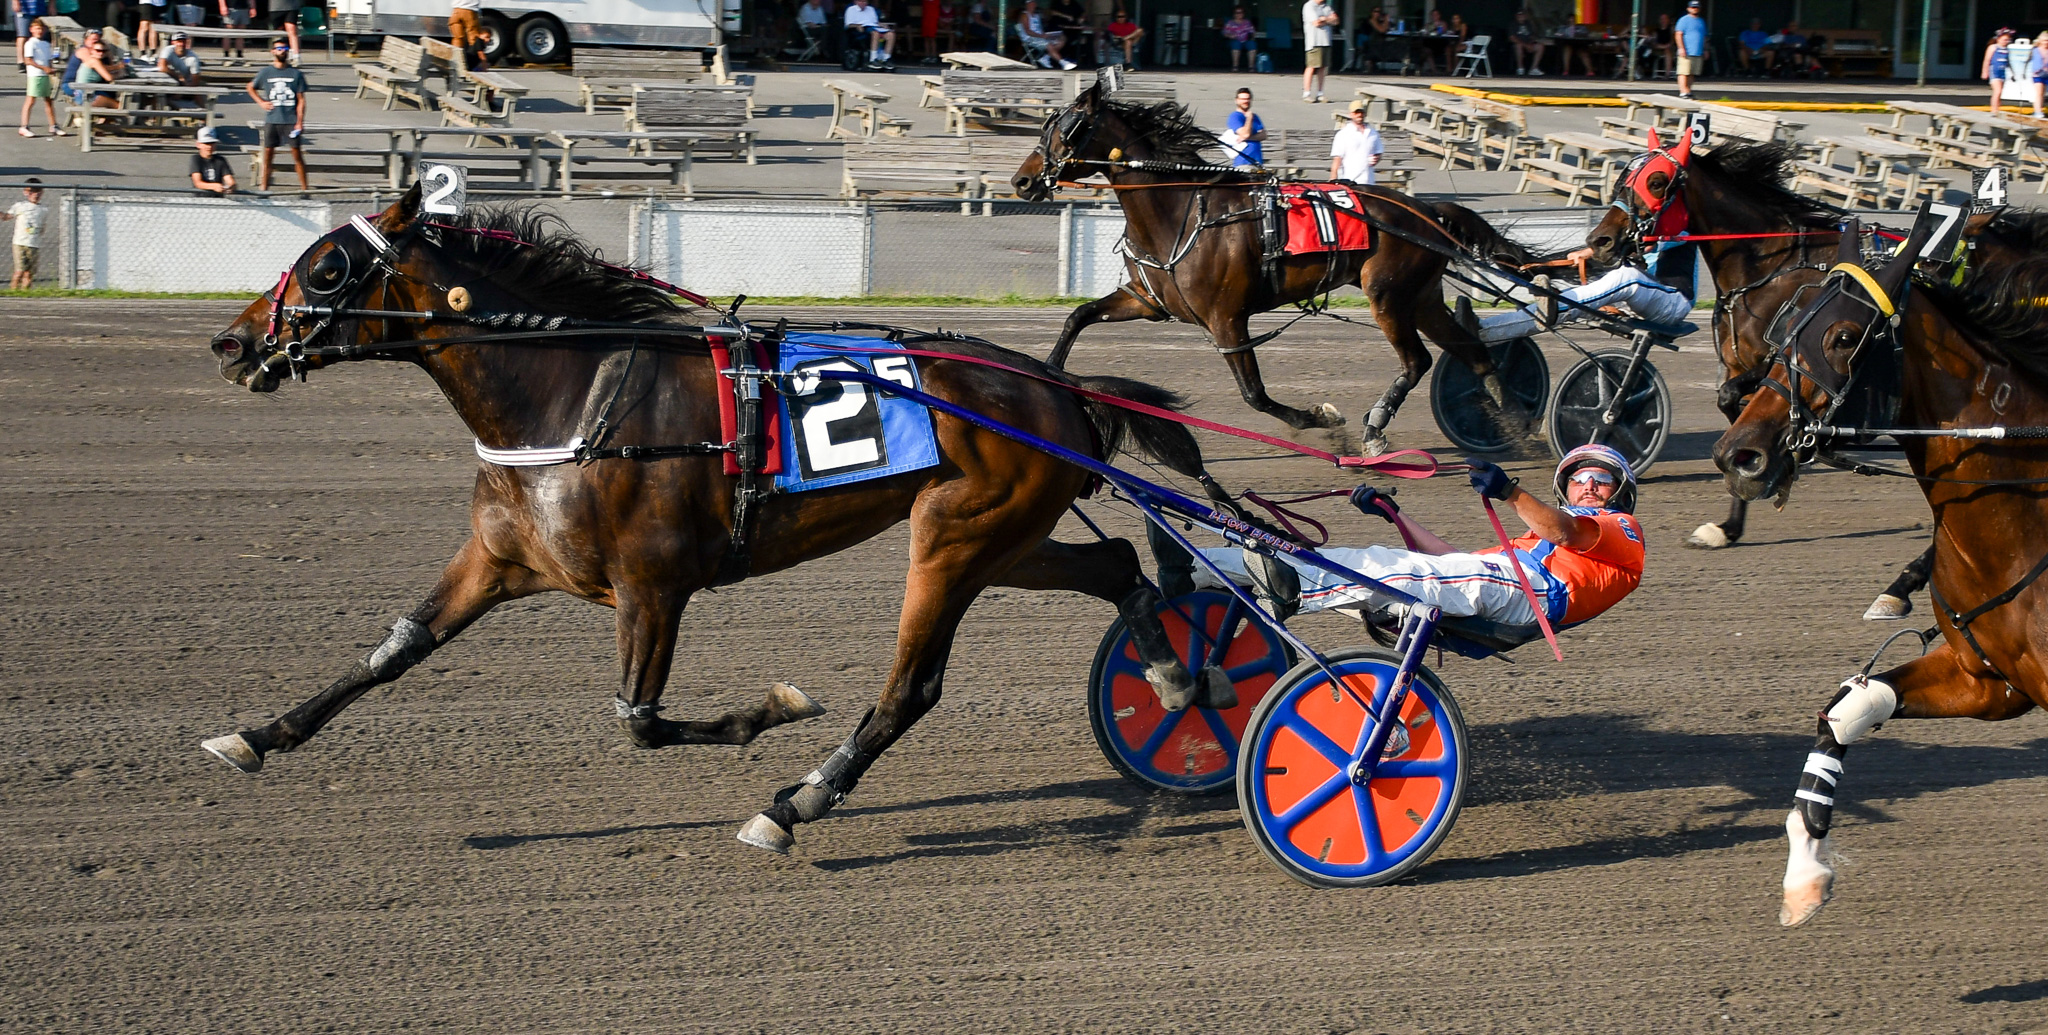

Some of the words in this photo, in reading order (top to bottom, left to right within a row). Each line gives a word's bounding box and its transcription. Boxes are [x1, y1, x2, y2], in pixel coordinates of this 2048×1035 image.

[1105, 66, 1118, 92] 1
[1691, 113, 1706, 144] 5
[425, 165, 458, 214] 2
[1328, 190, 1354, 209] 5
[1978, 168, 2006, 206] 4
[1919, 203, 1962, 257] 7
[873, 356, 914, 395] 5
[793, 361, 880, 472] 2
[1208, 510, 1249, 532] LEON
[1250, 528, 1301, 553] BAILEY
